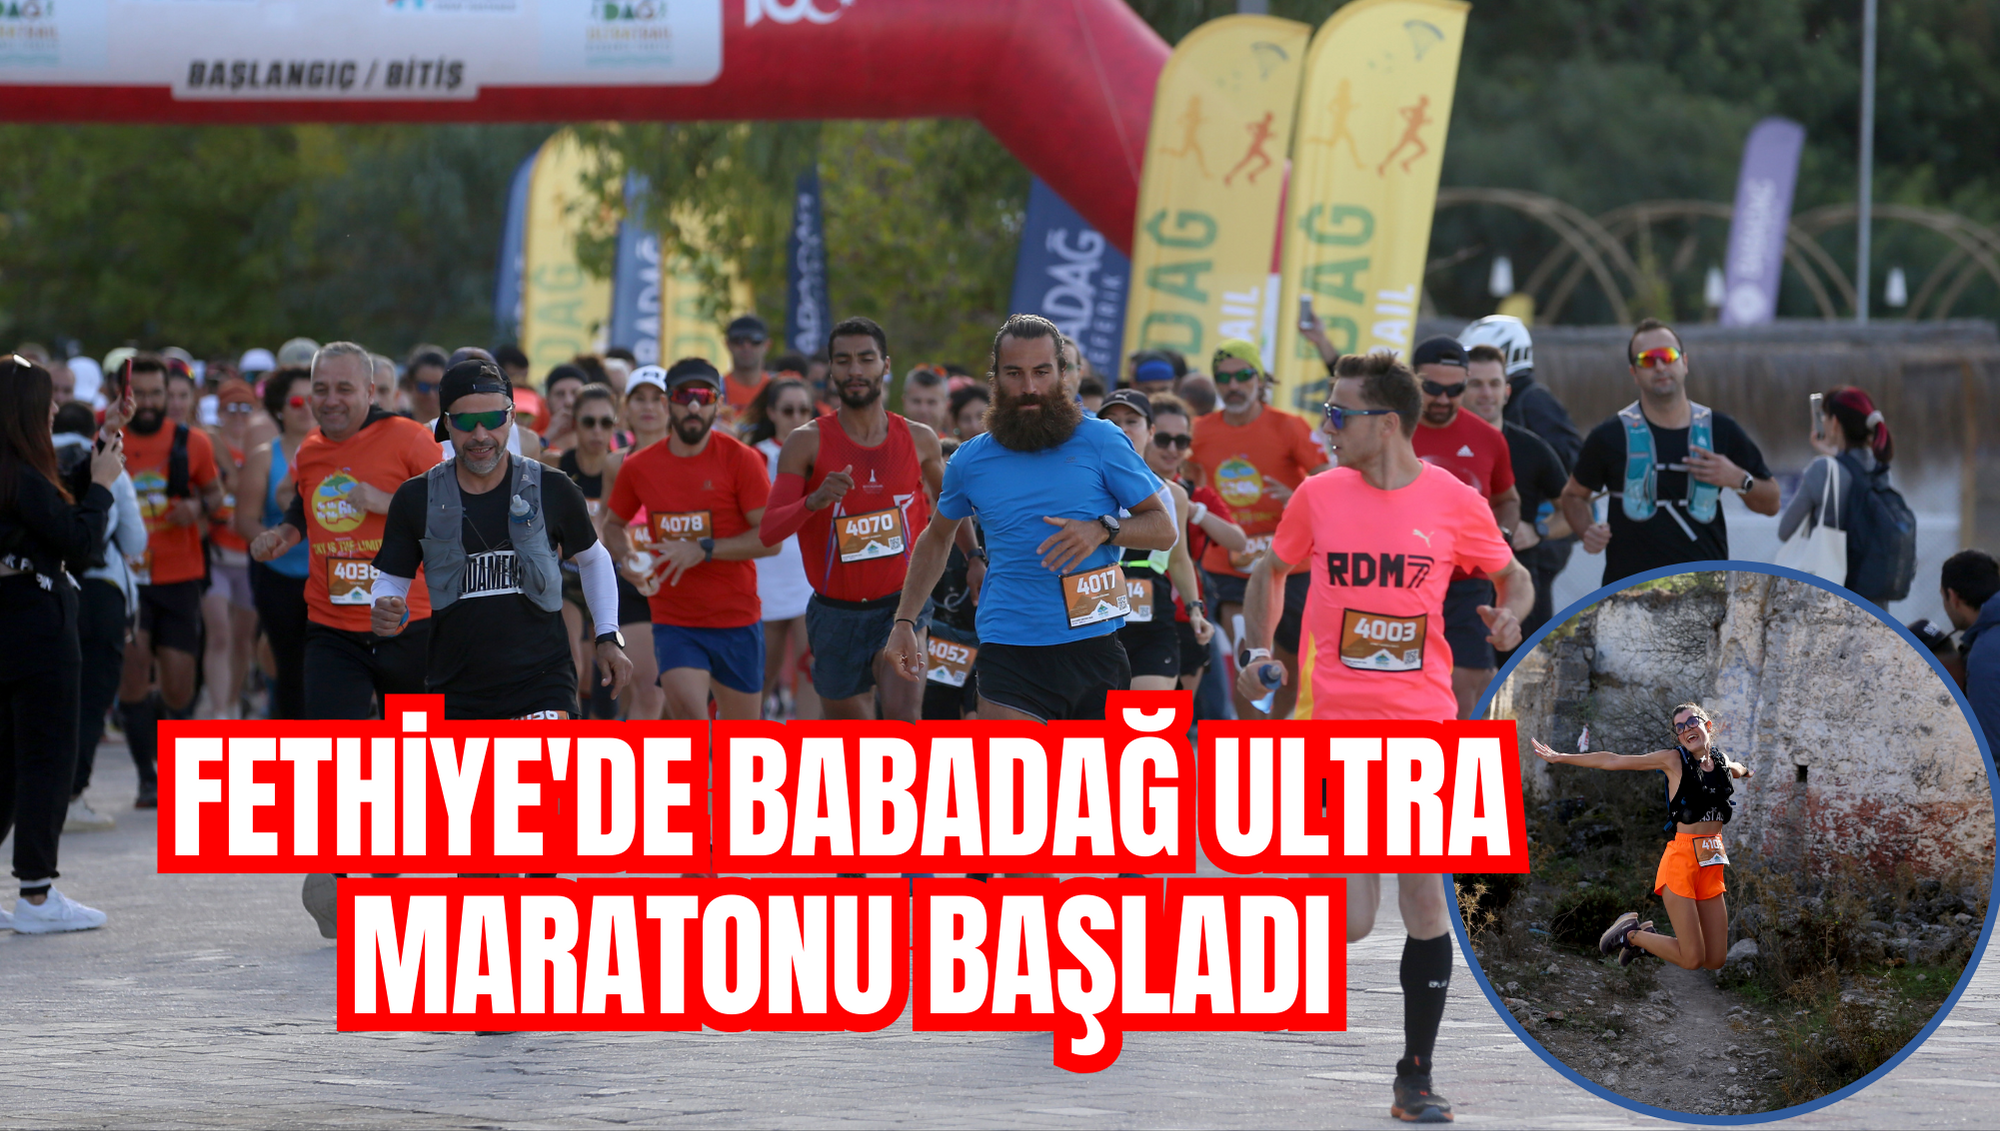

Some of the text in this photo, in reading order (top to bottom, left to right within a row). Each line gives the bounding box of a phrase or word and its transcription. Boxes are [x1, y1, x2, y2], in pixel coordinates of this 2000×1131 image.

[187, 59, 357, 92] BAŞLANGIÇ
[385, 55, 465, 92] BİTİŞ
[1138, 207, 1219, 366] DAĞ
[660, 515, 704, 533] 4078
[845, 513, 894, 537] 4070
[1076, 569, 1116, 595] 4017
[1353, 617, 1418, 642] 4003
